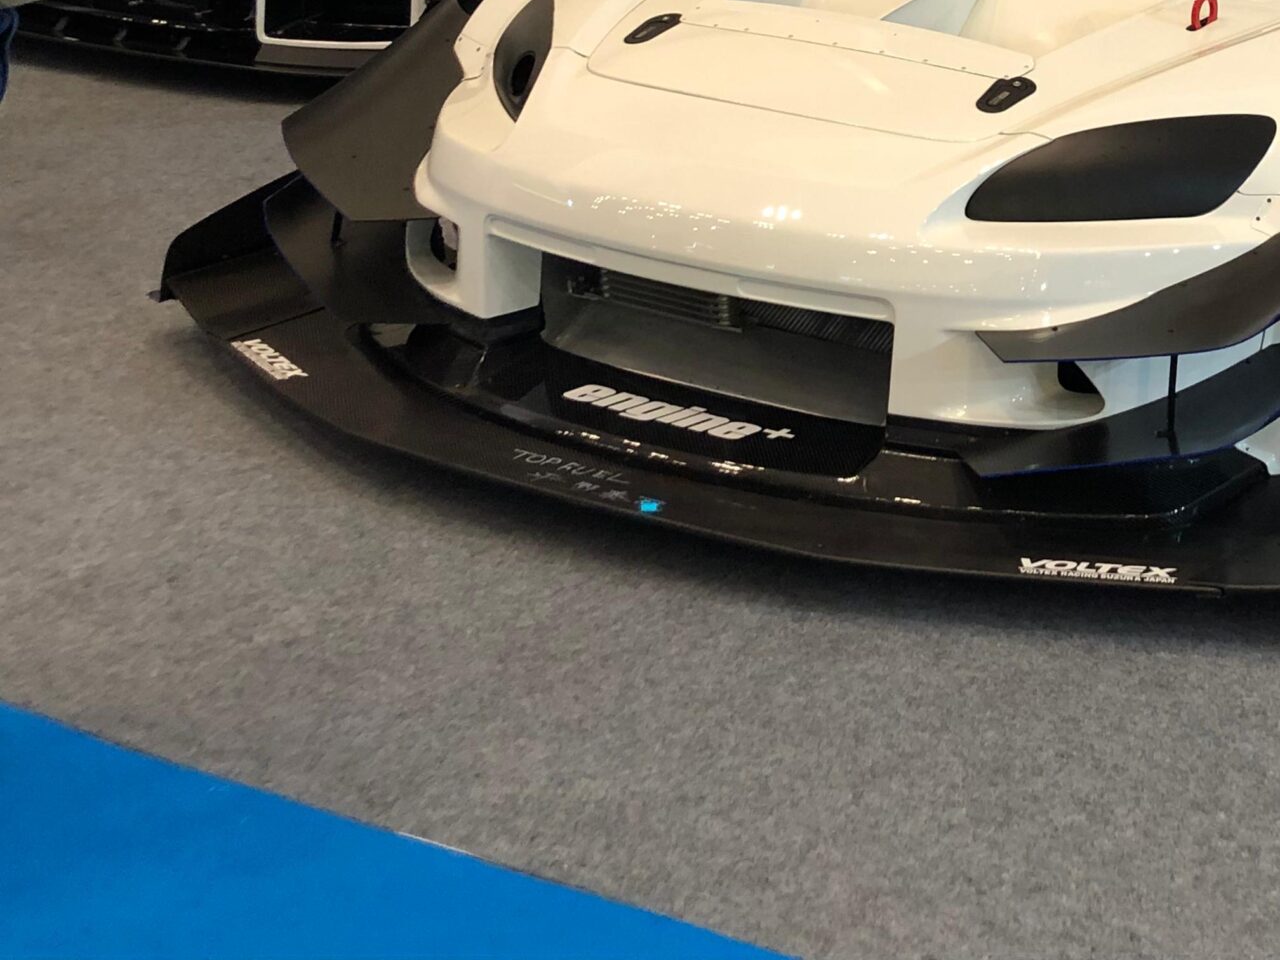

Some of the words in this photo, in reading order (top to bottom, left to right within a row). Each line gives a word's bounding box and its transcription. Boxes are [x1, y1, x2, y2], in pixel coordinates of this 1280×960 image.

[242, 338, 309, 379] VOLTEX
[1018, 566, 1057, 576] VOLTEX
[1060, 569, 1099, 579] RACING
[1100, 572, 1142, 582] SUZUKA
[1143, 575, 1177, 584] JAPAN
[1020, 557, 1178, 578] VOLTEX
